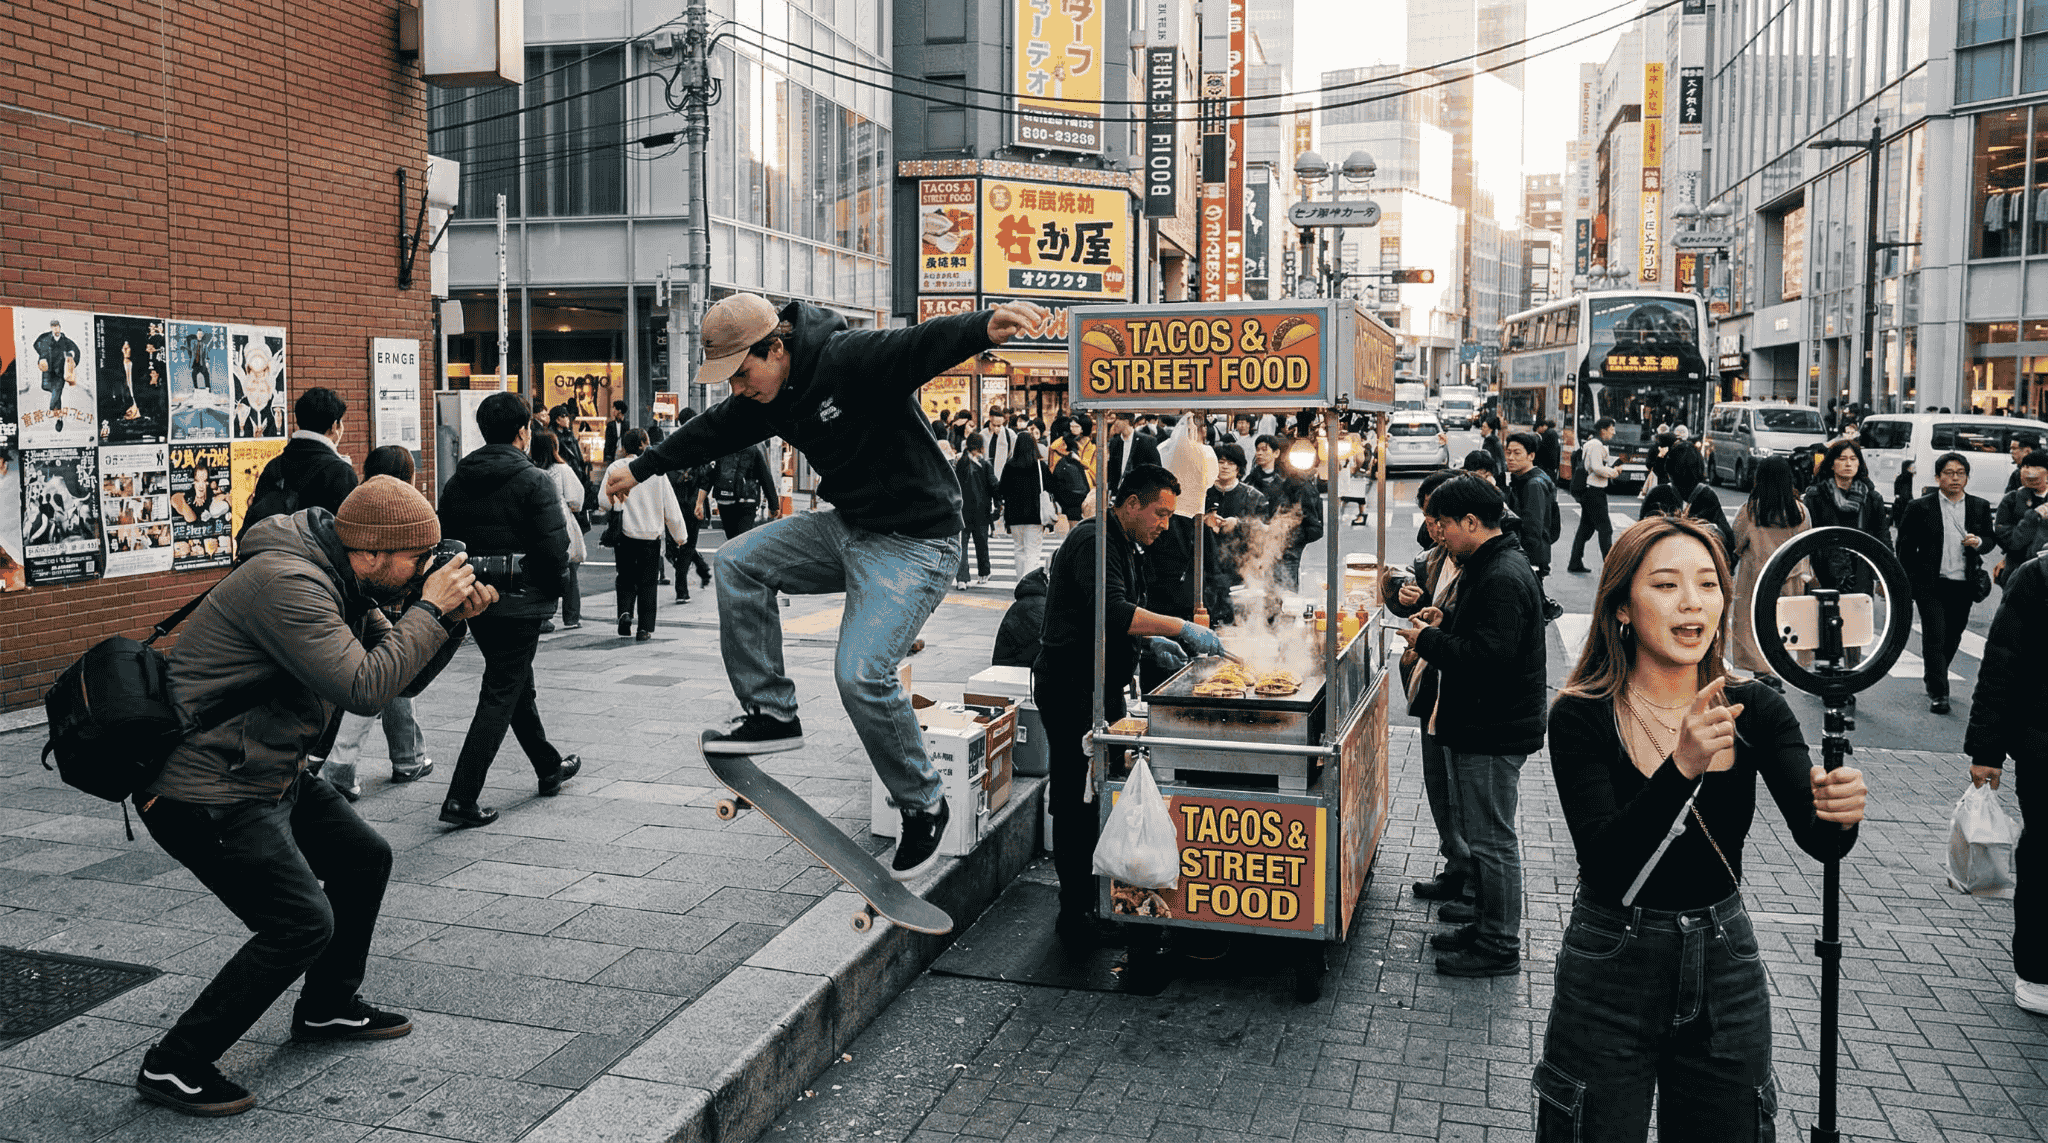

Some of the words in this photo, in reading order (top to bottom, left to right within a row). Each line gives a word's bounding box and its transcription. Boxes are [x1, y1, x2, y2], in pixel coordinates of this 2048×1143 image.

[923, 183, 960, 193] TACOS
[1127, 319, 1232, 354] TACOS
[1240, 319, 1267, 353] &
[1091, 357, 1211, 391] STREET
[1221, 356, 1309, 391] FOOD
[1181, 806, 1282, 848] TACOS
[1287, 821, 1308, 850] &
[1181, 848, 1306, 886] STREET
[1187, 883, 1299, 921] FOOD
